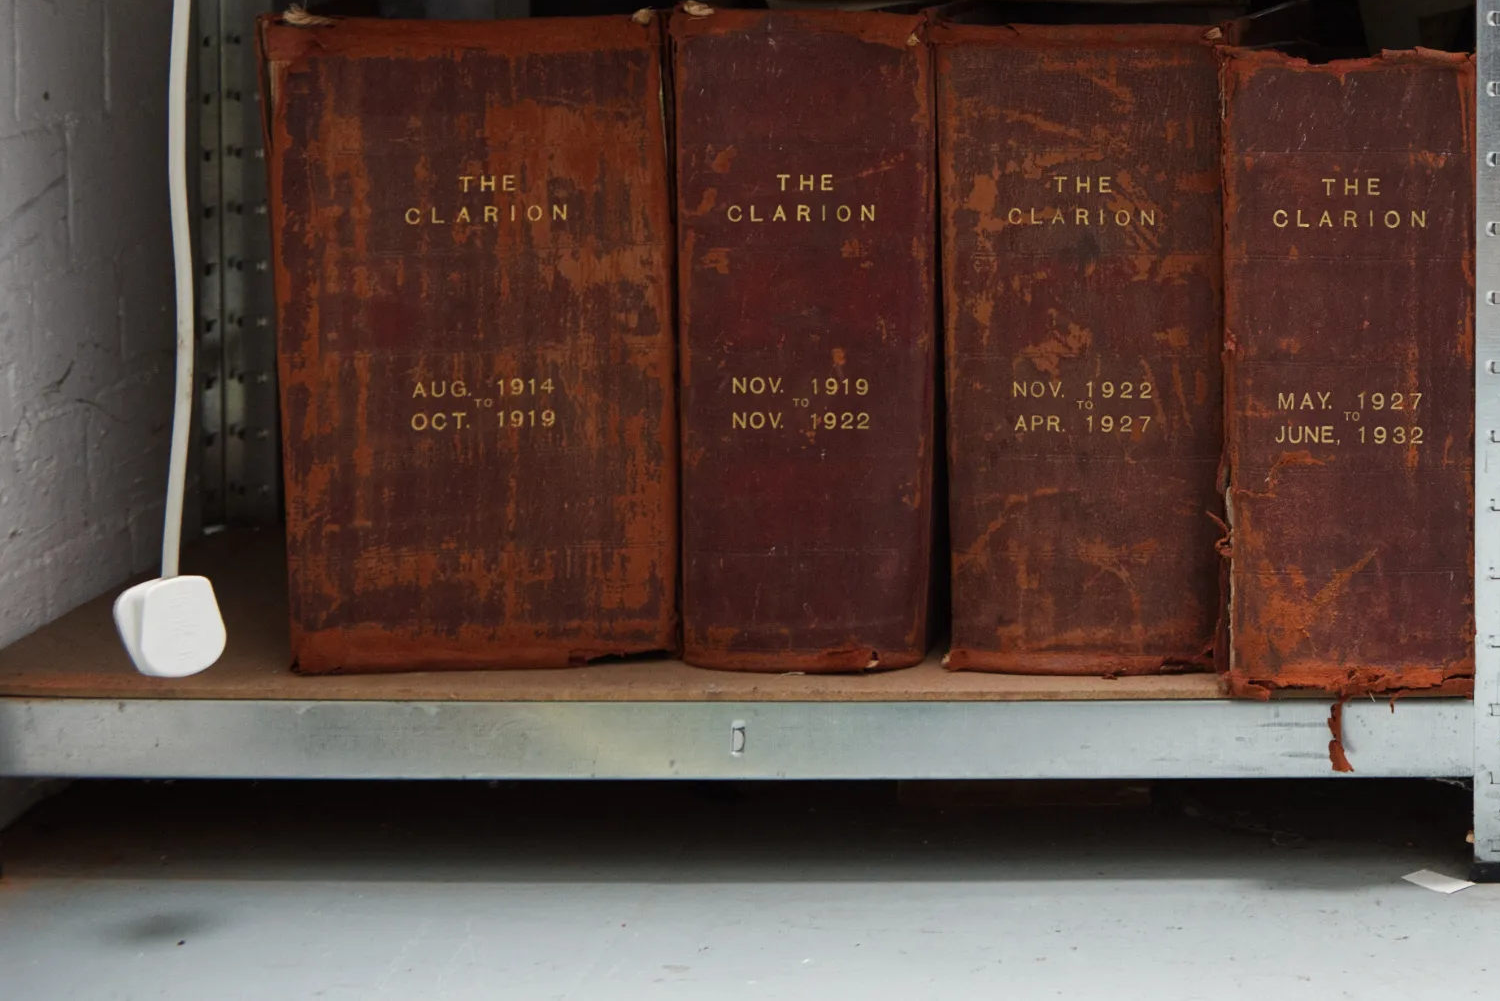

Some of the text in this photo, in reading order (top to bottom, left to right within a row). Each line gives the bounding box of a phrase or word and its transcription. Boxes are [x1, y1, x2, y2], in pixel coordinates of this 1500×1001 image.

[459, 174, 517, 193] THE
[775, 173, 835, 193] THE
[1053, 175, 1112, 194] THE
[1321, 178, 1381, 196] THE
[405, 204, 569, 225] CLARION
[727, 204, 876, 223] CLARION
[1007, 207, 1156, 227] CLARION
[1272, 209, 1427, 229] CLARION
[411, 378, 555, 399] AUG. 1914
[731, 377, 870, 396] NOV. 1919
[1012, 381, 1153, 399] NOV. 1922
[475, 397, 493, 408] TO
[793, 398, 809, 408] TO
[1076, 400, 1093, 410] TO
[1277, 392, 1423, 411] MAY. 1927
[410, 409, 556, 432] OCT. 1919
[731, 411, 870, 430] NOV. 1922
[1013, 415, 1152, 434] APR. 1927
[1343, 411, 1360, 422] TO
[1274, 425, 1424, 446] JUNE, 1932
